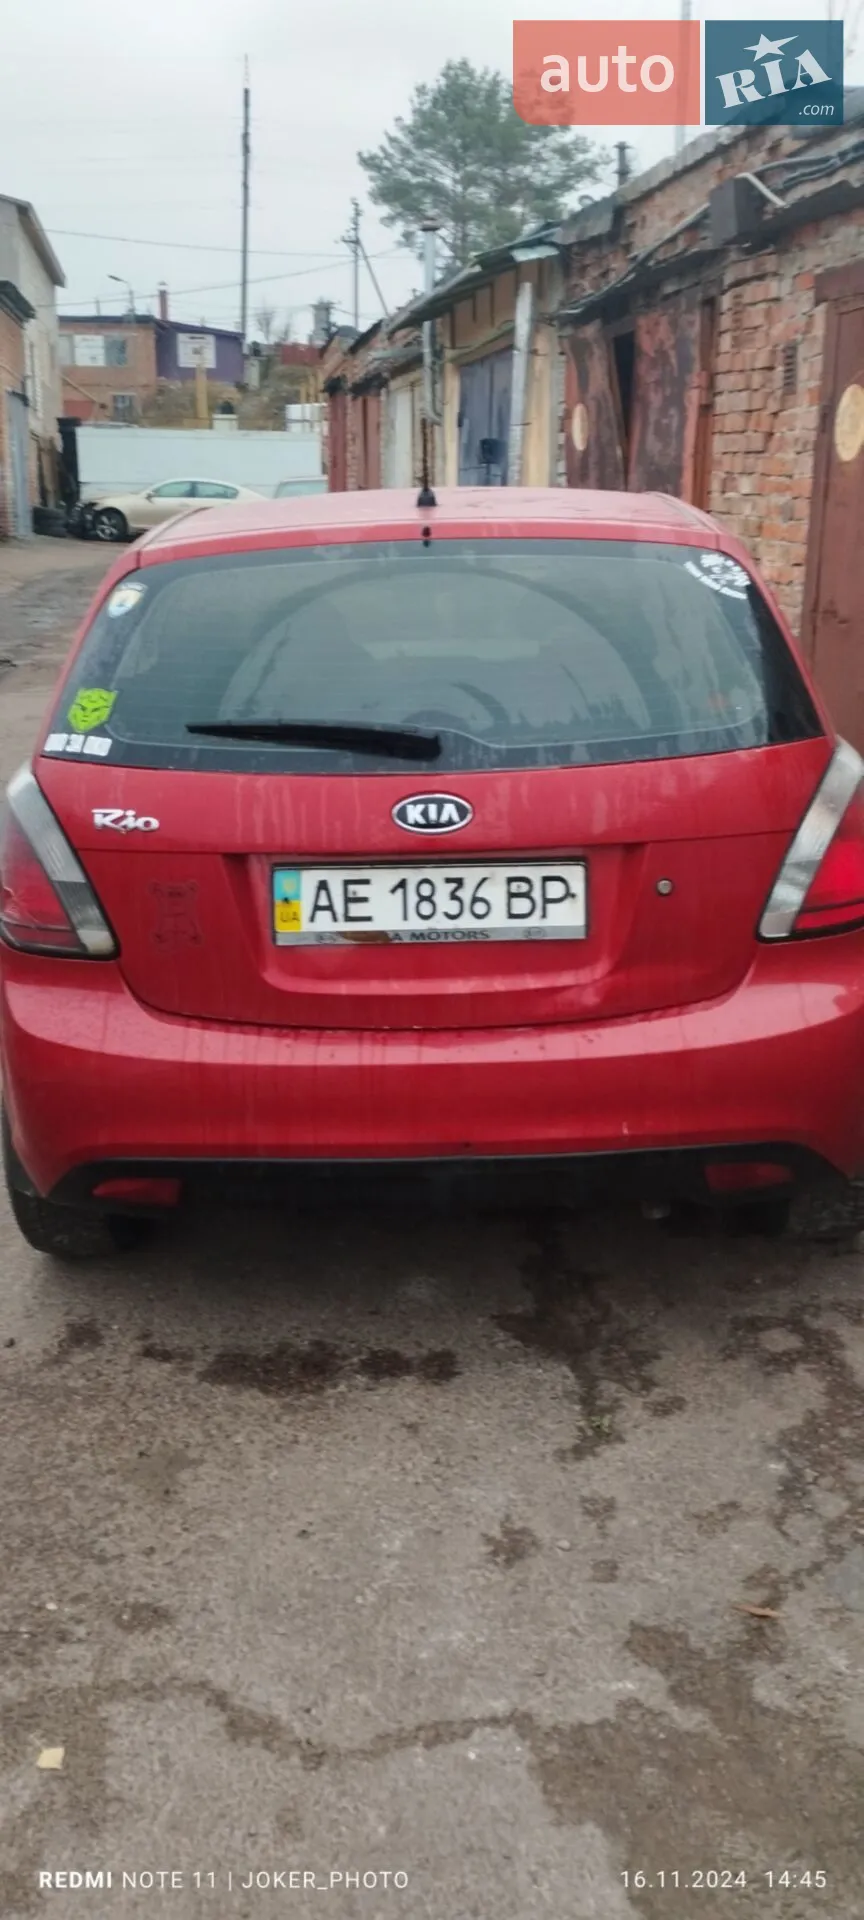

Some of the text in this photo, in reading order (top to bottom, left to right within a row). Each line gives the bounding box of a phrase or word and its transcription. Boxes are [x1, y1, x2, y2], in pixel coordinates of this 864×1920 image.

[92, 808, 159, 832] Rio
[406, 804, 460, 824] KIA
[309, 875, 570, 922] AE 1836 BP
[280, 911, 300, 922] UA
[410, 930, 490, 941] MOTORS
